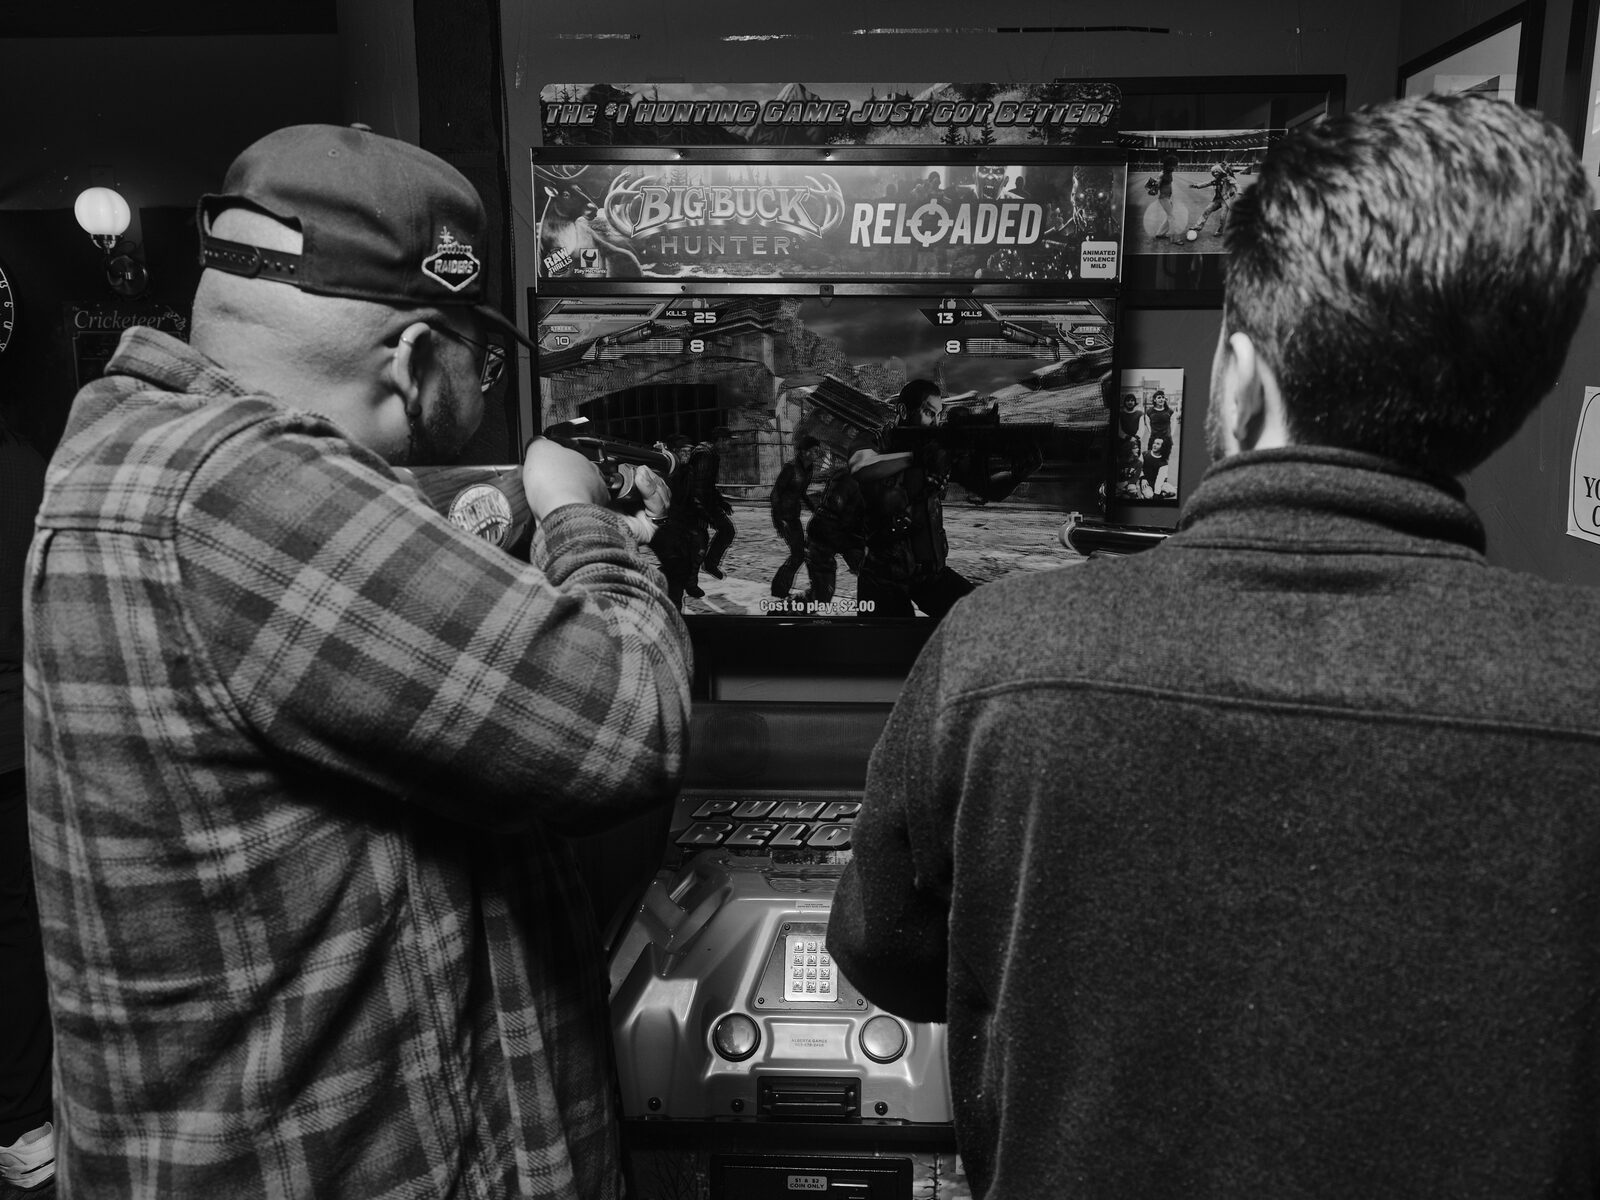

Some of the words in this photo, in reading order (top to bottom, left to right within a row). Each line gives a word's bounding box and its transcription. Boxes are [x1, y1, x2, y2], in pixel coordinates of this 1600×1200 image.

[546, 103, 597, 124] THE
[604, 102, 630, 124] #1
[634, 102, 759, 125] HUNTING
[762, 102, 849, 125] GAME
[851, 102, 929, 125] JUST
[932, 102, 993, 125] GOT
[995, 102, 1114, 125] BETTER!
[631, 186, 706, 237] BIG
[709, 186, 822, 238] BUCK
[850, 199, 1043, 247] RELOADED
[660, 236, 790, 255] HUNTER
[434, 258, 474, 274] RAIDERS
[543, 247, 569, 269] RAW
[548, 256, 573, 274] THRILLS
[74, 309, 166, 329] Cricketeer
[693, 312, 717, 324] 25
[937, 312, 954, 325] 13
[555, 336, 570, 346] 10
[690, 339, 705, 353] 8
[946, 340, 961, 353] 8
[1085, 337, 1095, 346] 6
[760, 600, 788, 611] Cost
[791, 600, 805, 611] to
[807, 599, 837, 614] play:
[840, 599, 875, 612] $2.00
[691, 800, 863, 820] PUMP
